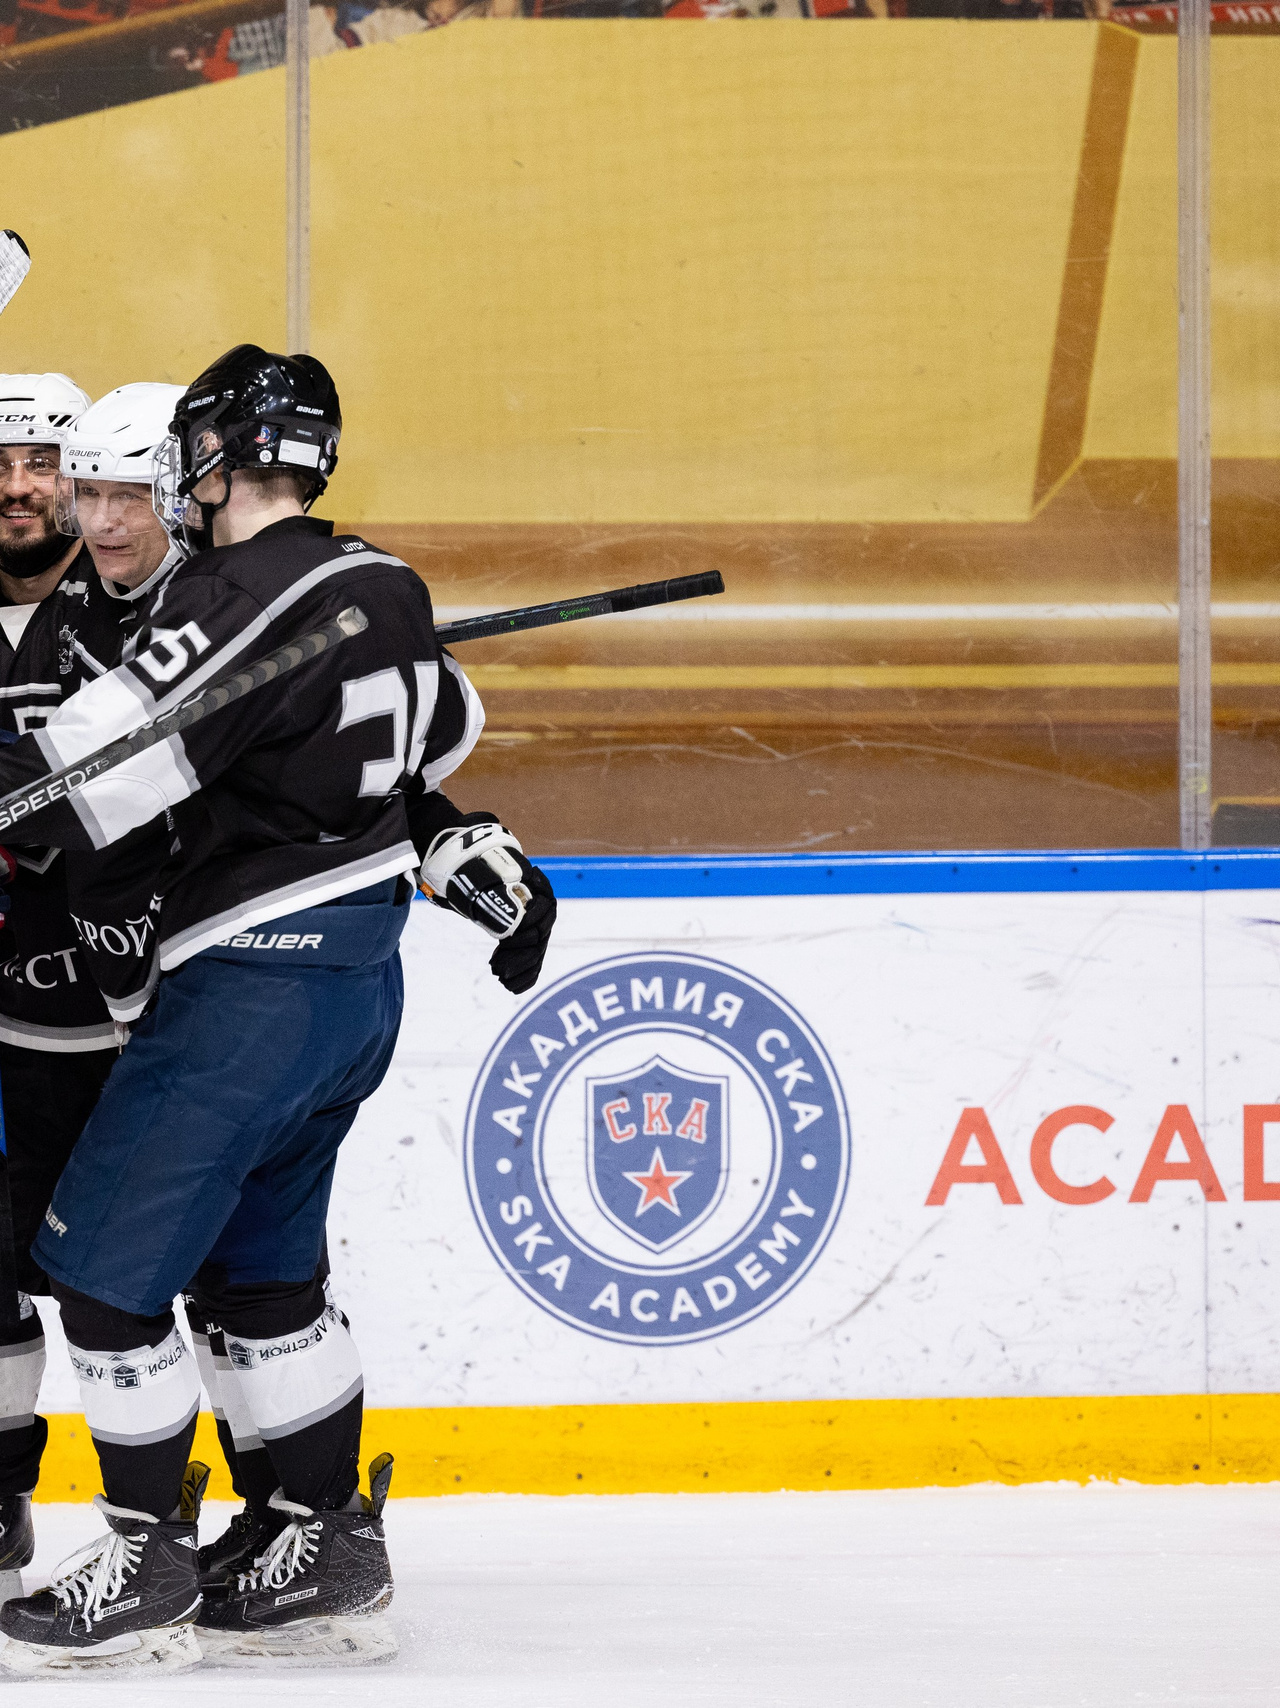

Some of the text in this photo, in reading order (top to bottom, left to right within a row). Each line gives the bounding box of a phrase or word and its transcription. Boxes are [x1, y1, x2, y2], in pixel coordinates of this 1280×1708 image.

[341, 541, 366, 552] LUTCH
[487, 890, 515, 913] CCM
[493, 976, 824, 1137] АКАДЕМИЯ СКА
[601, 1091, 710, 1144] СКА
[499, 1188, 816, 1323] SKA ACADEMY
[102, 1599, 138, 1616] BAUER
[278, 1588, 316, 1604] BAUER
